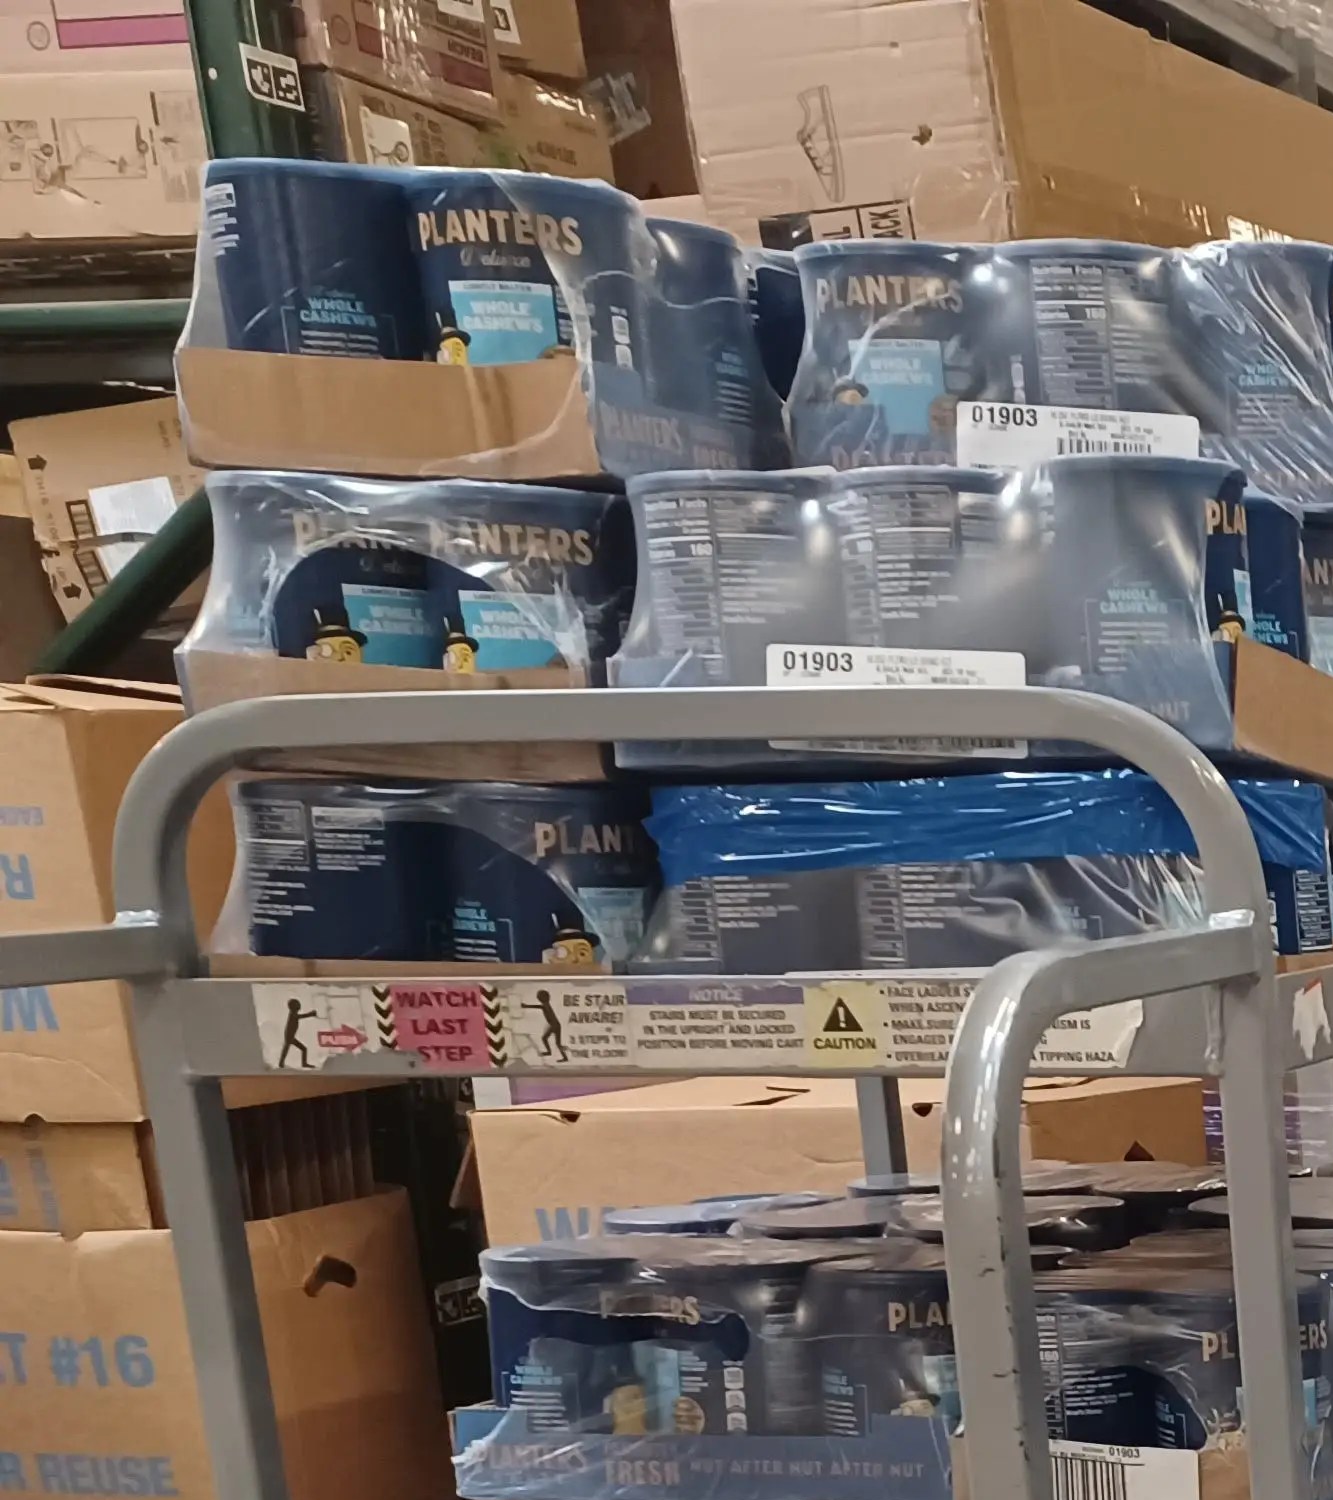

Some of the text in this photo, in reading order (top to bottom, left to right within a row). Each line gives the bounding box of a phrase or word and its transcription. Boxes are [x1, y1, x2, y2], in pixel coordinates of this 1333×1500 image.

[418, 209, 584, 256] PLANTERS
[816, 275, 962, 314] PLANTERS
[971, 405, 1038, 428] 01903
[782, 651, 853, 673] 01903
[394, 991, 478, 1008] WATCH
[563, 994, 626, 1007] BE STAIR
[688, 988, 743, 1002] NOTICE
[568, 1010, 624, 1024] AWARE!
[738, 1009, 785, 1019] SECURED
[411, 1019, 468, 1035] LAST
[679, 1025, 725, 1035] UPRIGHT
[729, 1025, 751, 1035] AND
[754, 1024, 795, 1035] LOCKED
[637, 1039, 685, 1049] POSITION
[731, 1038, 774, 1048] MOVING
[813, 1036, 877, 1051] CAUTION
[893, 1034, 947, 1045] ENGAGED
[415, 1046, 473, 1062] STEP
[50, 1335, 155, 1387] #16
[1108, 1446, 1141, 1459] 01903
[36, 1453, 179, 1496] REUSE
